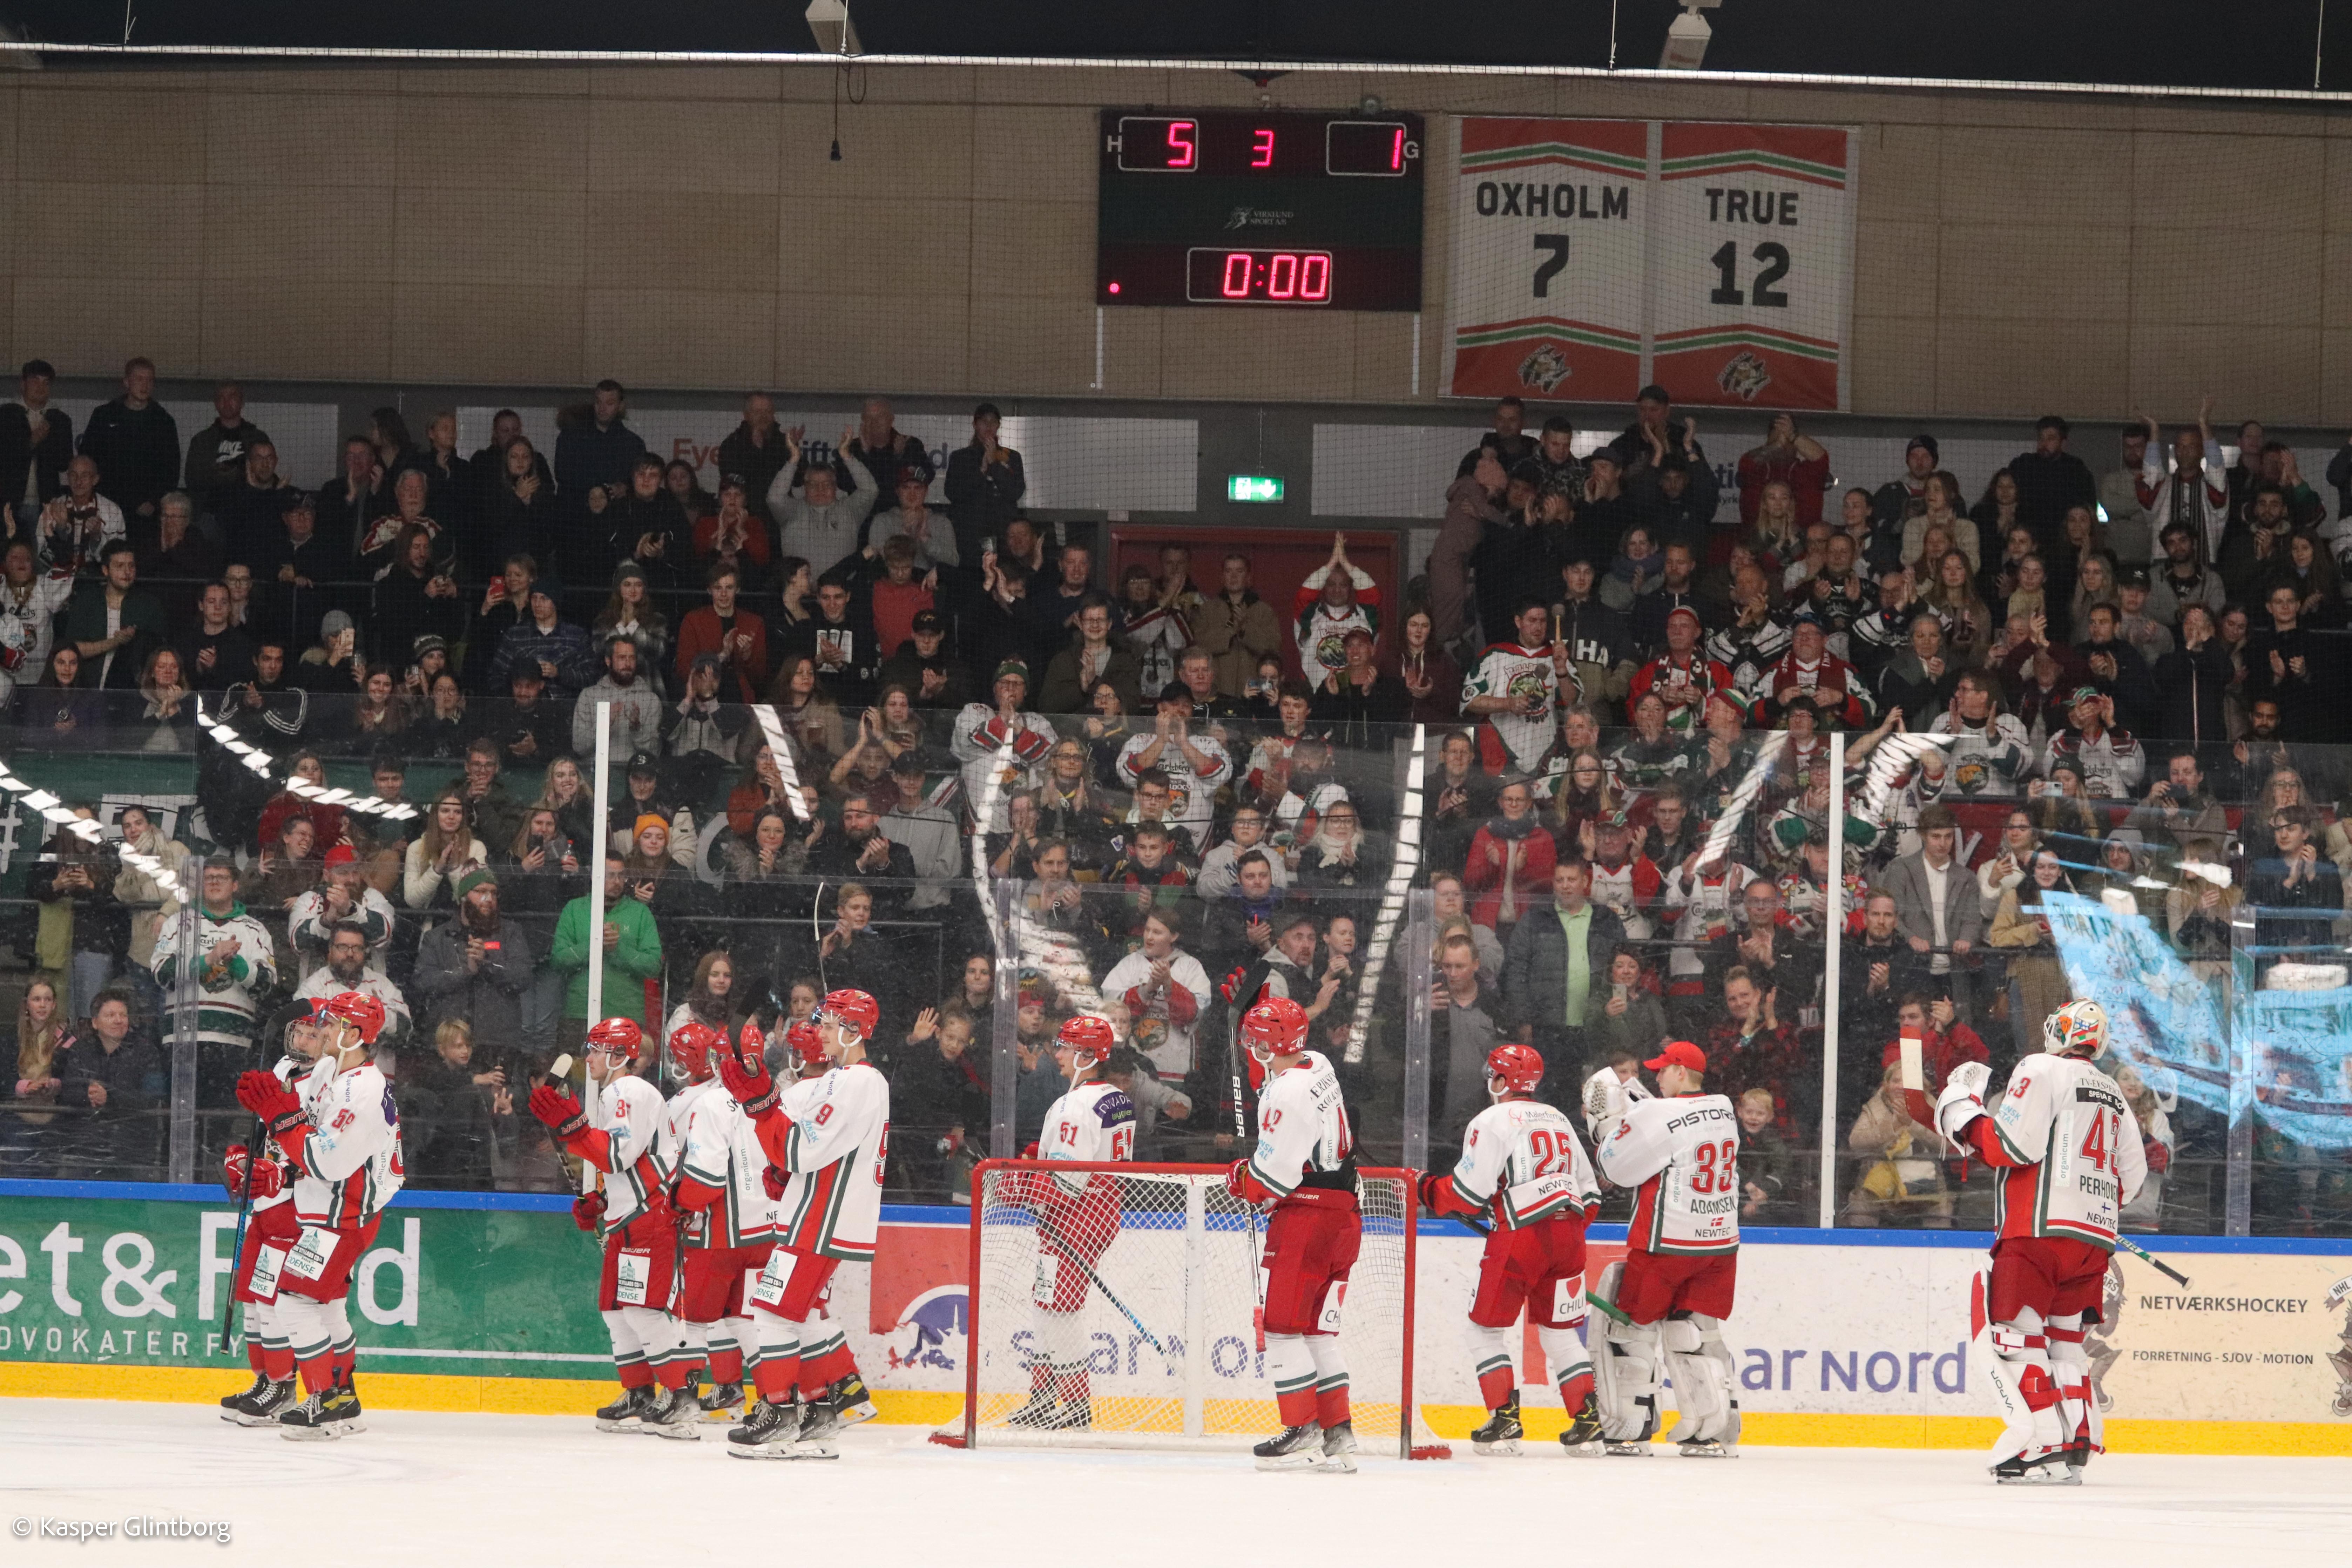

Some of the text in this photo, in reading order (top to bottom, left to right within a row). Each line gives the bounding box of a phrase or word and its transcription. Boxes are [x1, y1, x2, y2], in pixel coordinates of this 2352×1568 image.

[1107, 135, 1122, 153] H
[1168, 122, 1194, 166] 5
[1251, 130, 1275, 167] 3
[1404, 141, 1419, 159] G
[1476, 181, 1629, 220] OXHOLM
[1706, 188, 1799, 225] TRUE
[1223, 254, 1329, 298] 0:00
[1533, 234, 1569, 298] 7
[1711, 241, 1790, 307] 12
[815, 1103, 834, 1126] 9
[1232, 1076, 1245, 1138] BAUER
[1060, 1122, 1079, 1148] 51
[377, 1150, 387, 1186] ganicum
[741, 1147, 751, 1190] organicum
[1529, 1129, 1572, 1179] 25
[1690, 1138, 1737, 1195] 33
[2060, 1133, 2069, 1179] organicum
[1690, 1197, 1737, 1215] ADAMSEN
[2086, 1211, 2116, 1230] NEWTEC
[1695, 1227, 1731, 1238] NEWTEC
[755, 1287, 776, 1300] DENSE
[2140, 1295, 2308, 1313] NETVÆRKSHOCKEY
[2332, 1280, 2351, 1296] NHL
[207, 1334, 245, 1359] FY
[2133, 1350, 2211, 1363] FORRETNING
[2222, 1351, 2252, 1364] SJOV
[2263, 1352, 2314, 1365] MOTION
[1821, 1341, 1966, 1394] Nord
[1991, 1365, 2014, 1416] VAPOR
